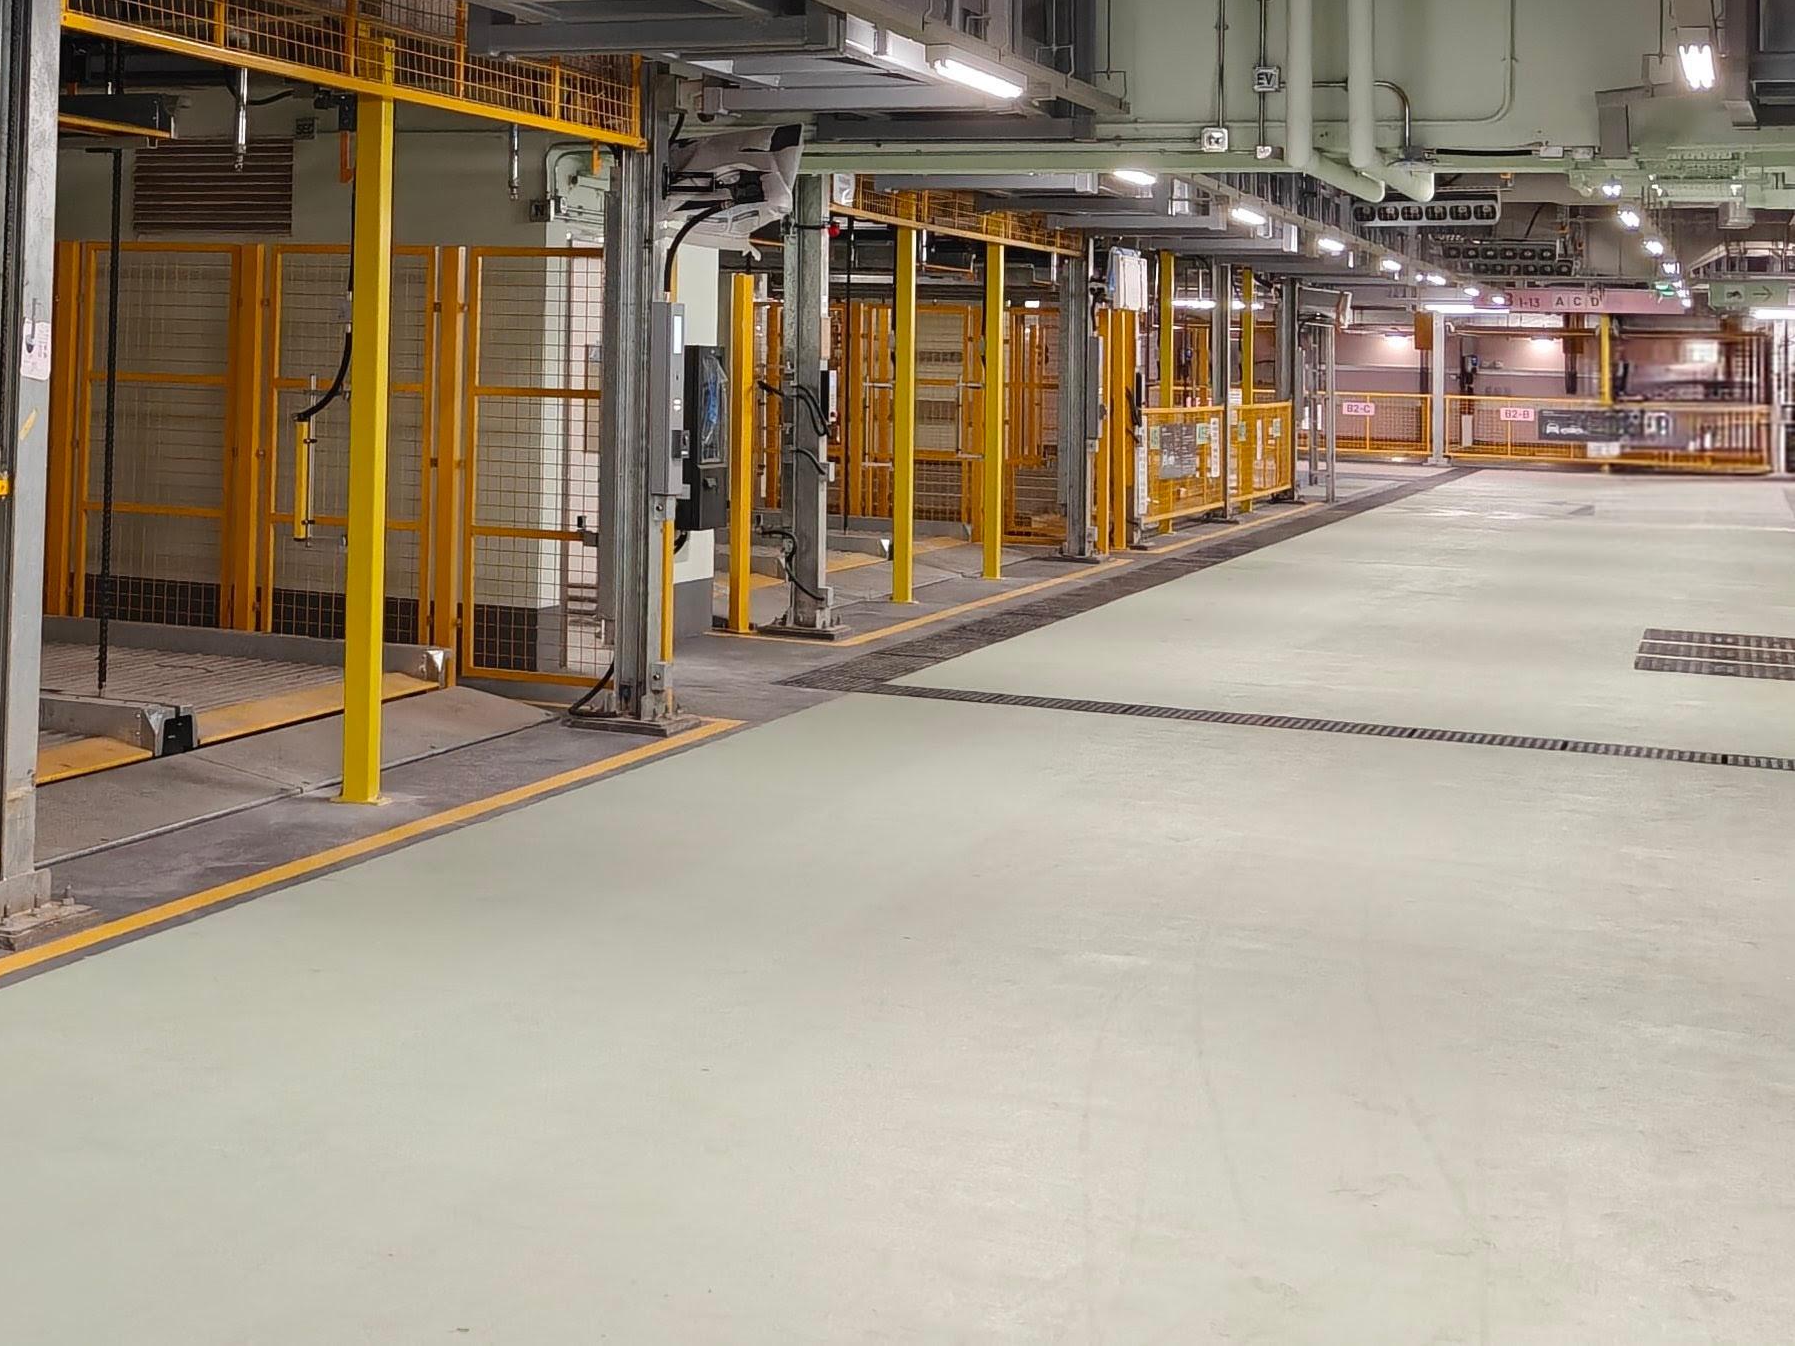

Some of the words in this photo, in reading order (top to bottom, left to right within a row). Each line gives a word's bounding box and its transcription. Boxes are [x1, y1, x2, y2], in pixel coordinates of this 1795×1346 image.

[1257, 71, 1273, 85] EV
[1555, 297, 1564, 307] A
[1573, 297, 1582, 307] C
